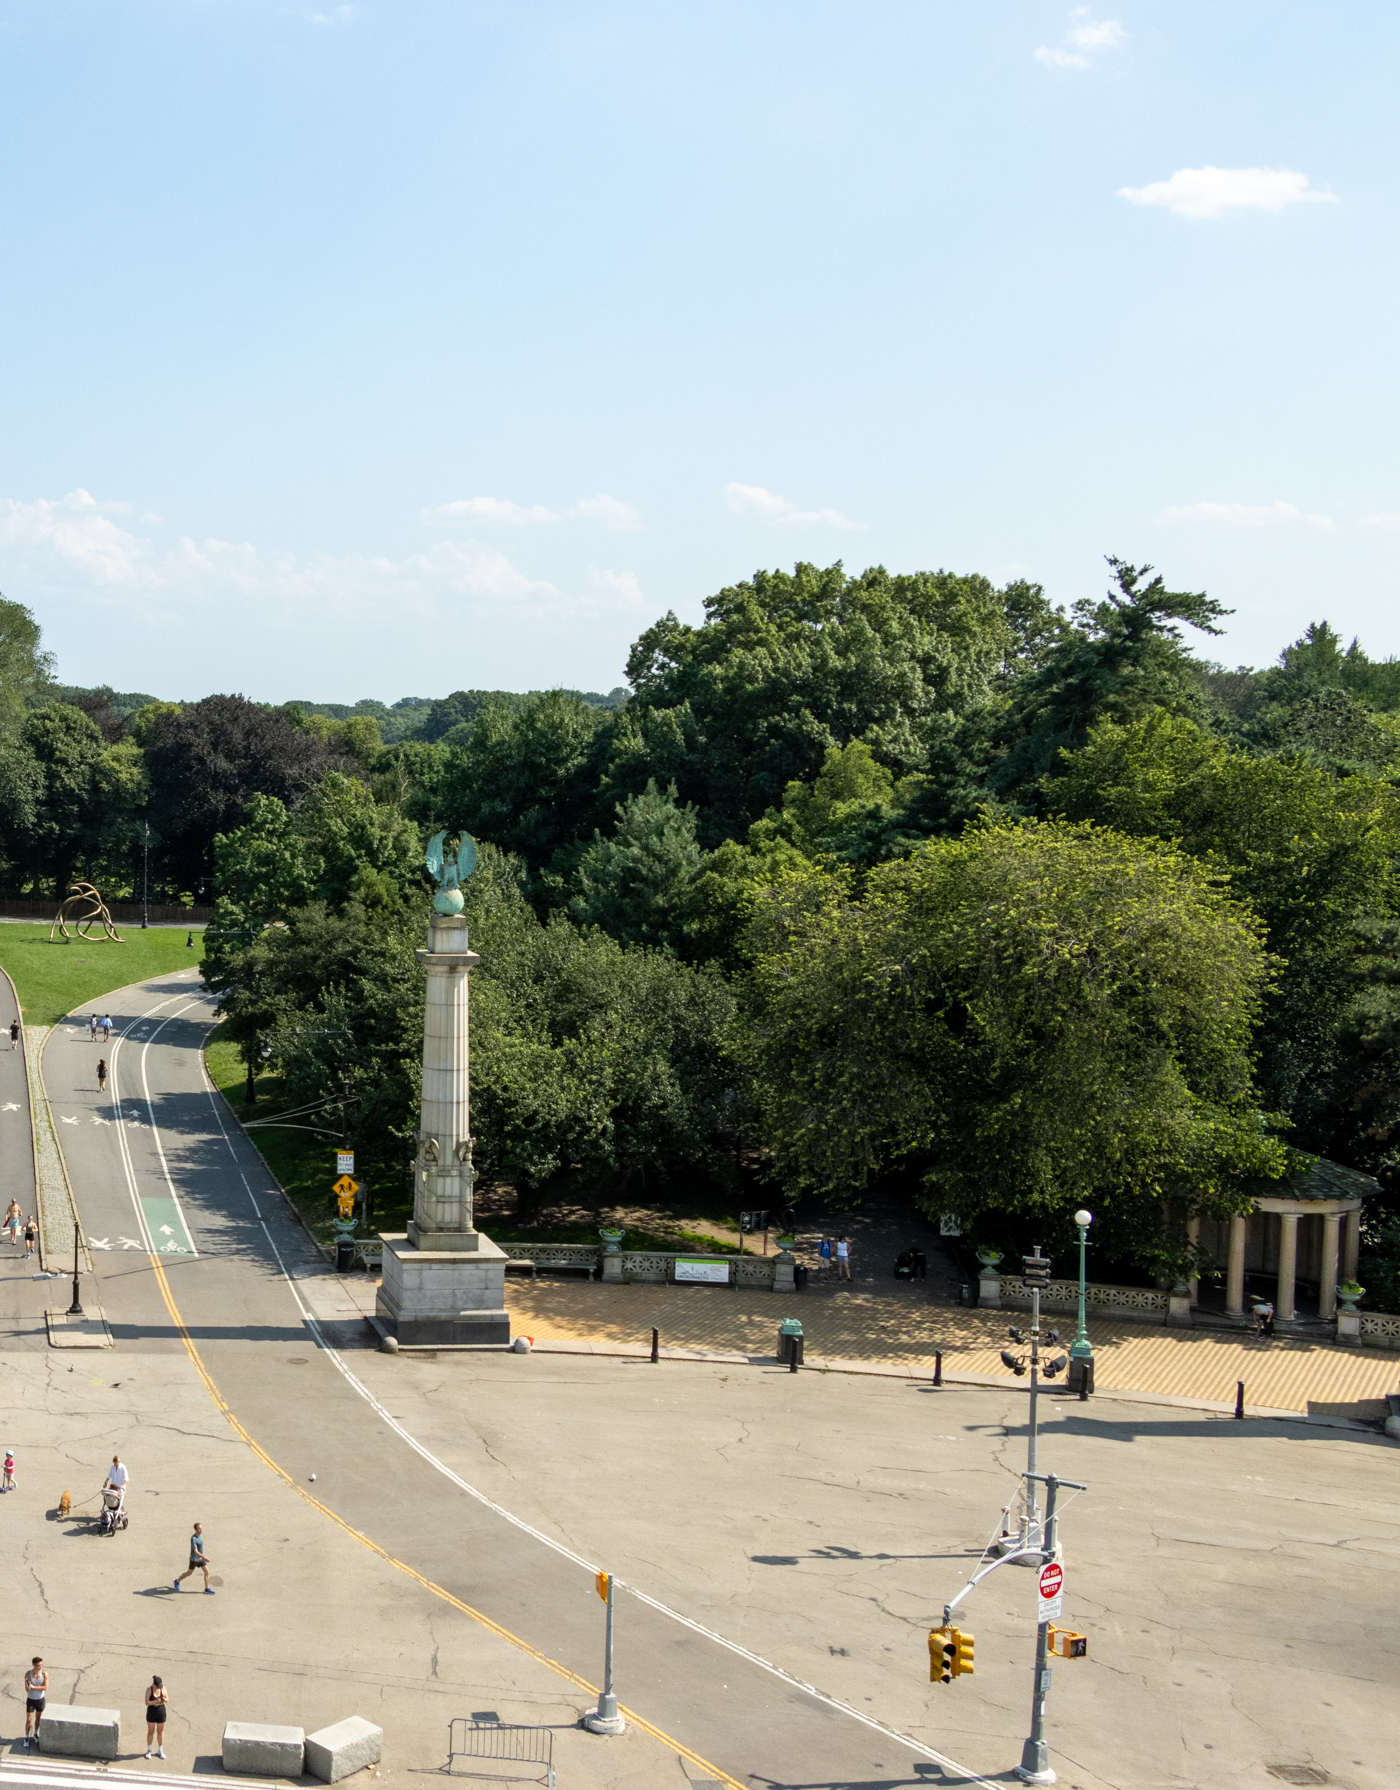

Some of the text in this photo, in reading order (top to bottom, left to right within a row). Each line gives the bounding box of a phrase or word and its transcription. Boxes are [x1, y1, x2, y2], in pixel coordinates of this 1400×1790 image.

[1051, 1568, 1060, 1576] NOT
[1043, 1584, 1058, 1594] ENTER
[1040, 1605, 1060, 1614] AUTHORIZED
[1042, 1612, 1058, 1620] VEHICLES
